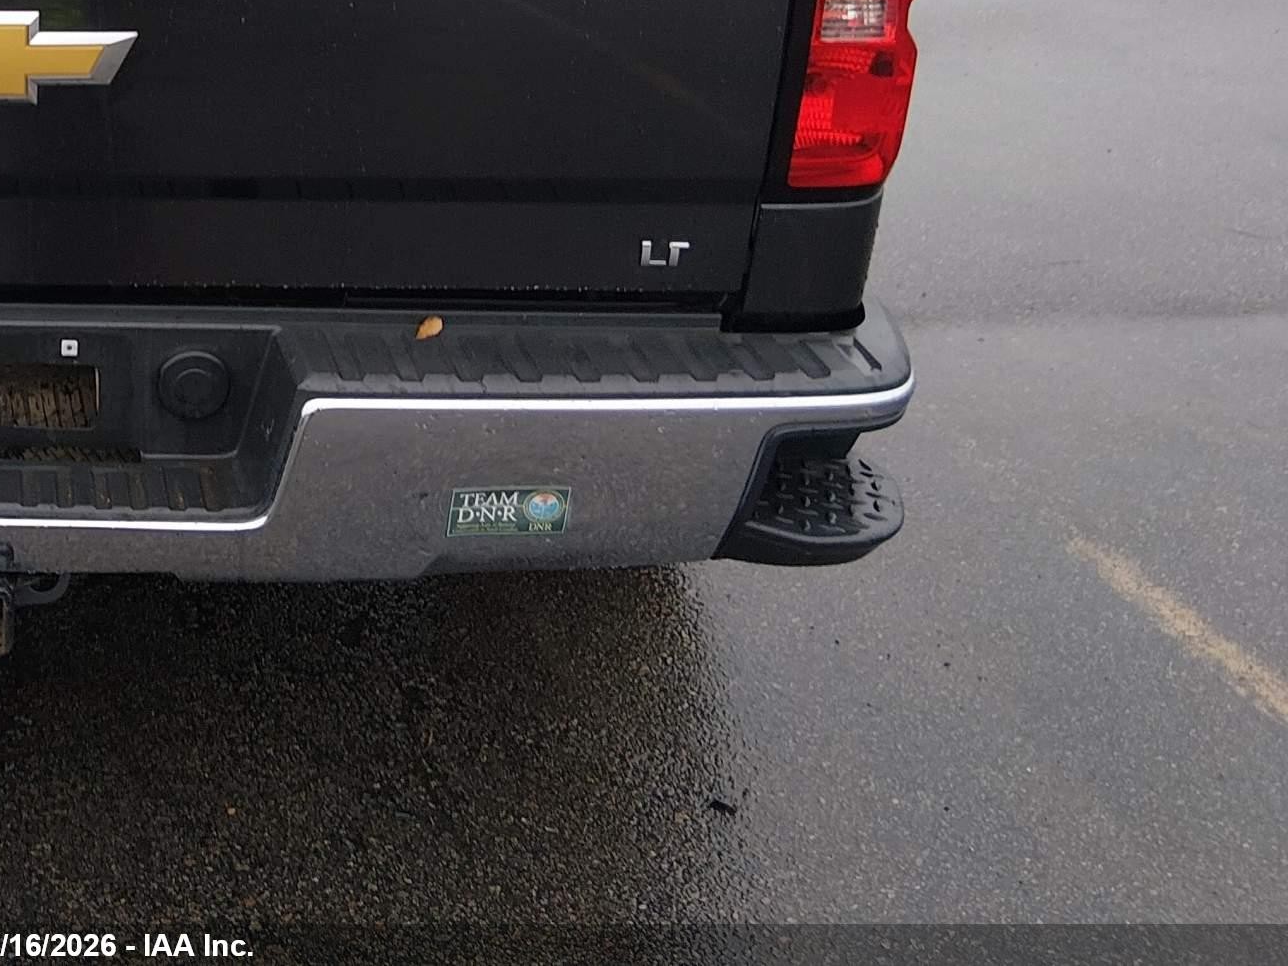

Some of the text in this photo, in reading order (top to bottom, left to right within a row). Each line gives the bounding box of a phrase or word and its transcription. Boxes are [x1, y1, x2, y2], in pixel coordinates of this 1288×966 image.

[640, 240, 691, 267] LT
[460, 491, 519, 507] TEAM
[528, 522, 553, 532] DNR
